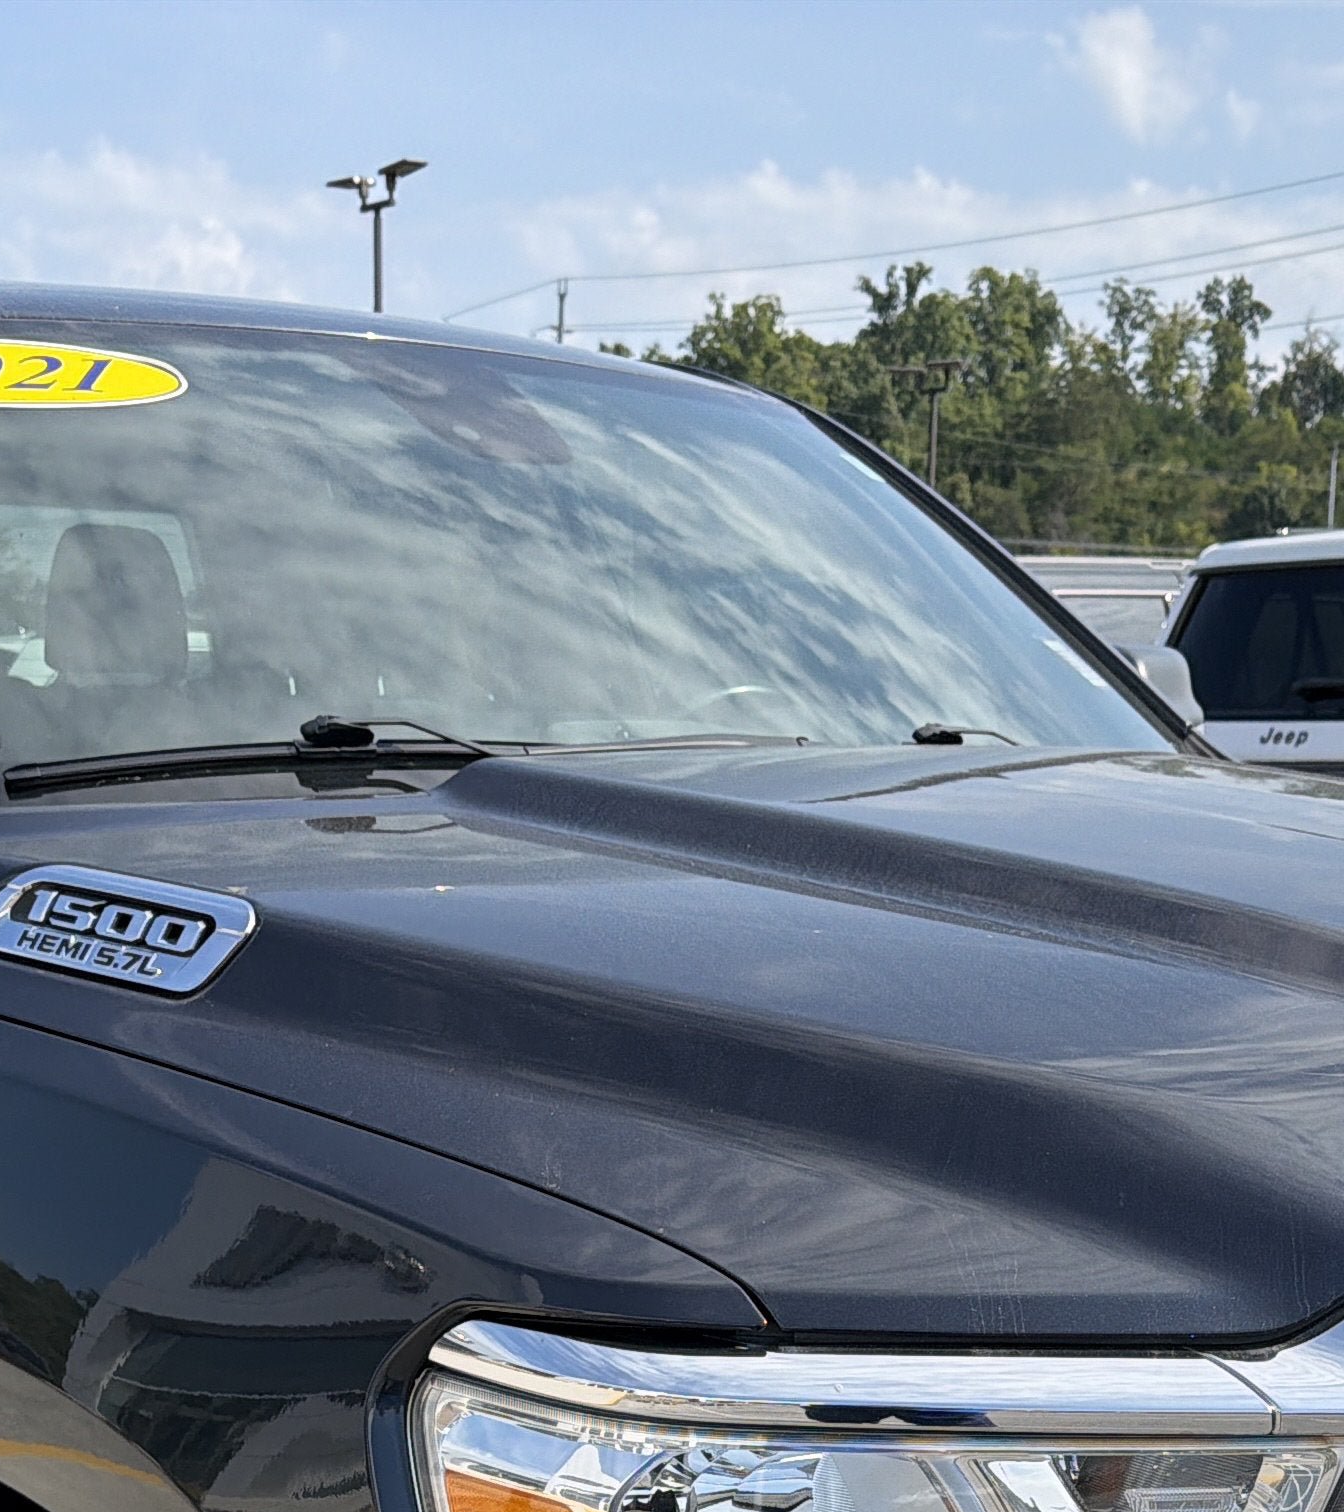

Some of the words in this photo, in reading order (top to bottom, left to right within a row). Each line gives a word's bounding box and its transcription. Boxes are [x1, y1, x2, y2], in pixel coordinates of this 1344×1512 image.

[1259, 727, 1309, 748] Jeep
[27, 889, 207, 953] 1500
[17, 929, 93, 961] HEMI
[93, 945, 163, 977] 5.7L
